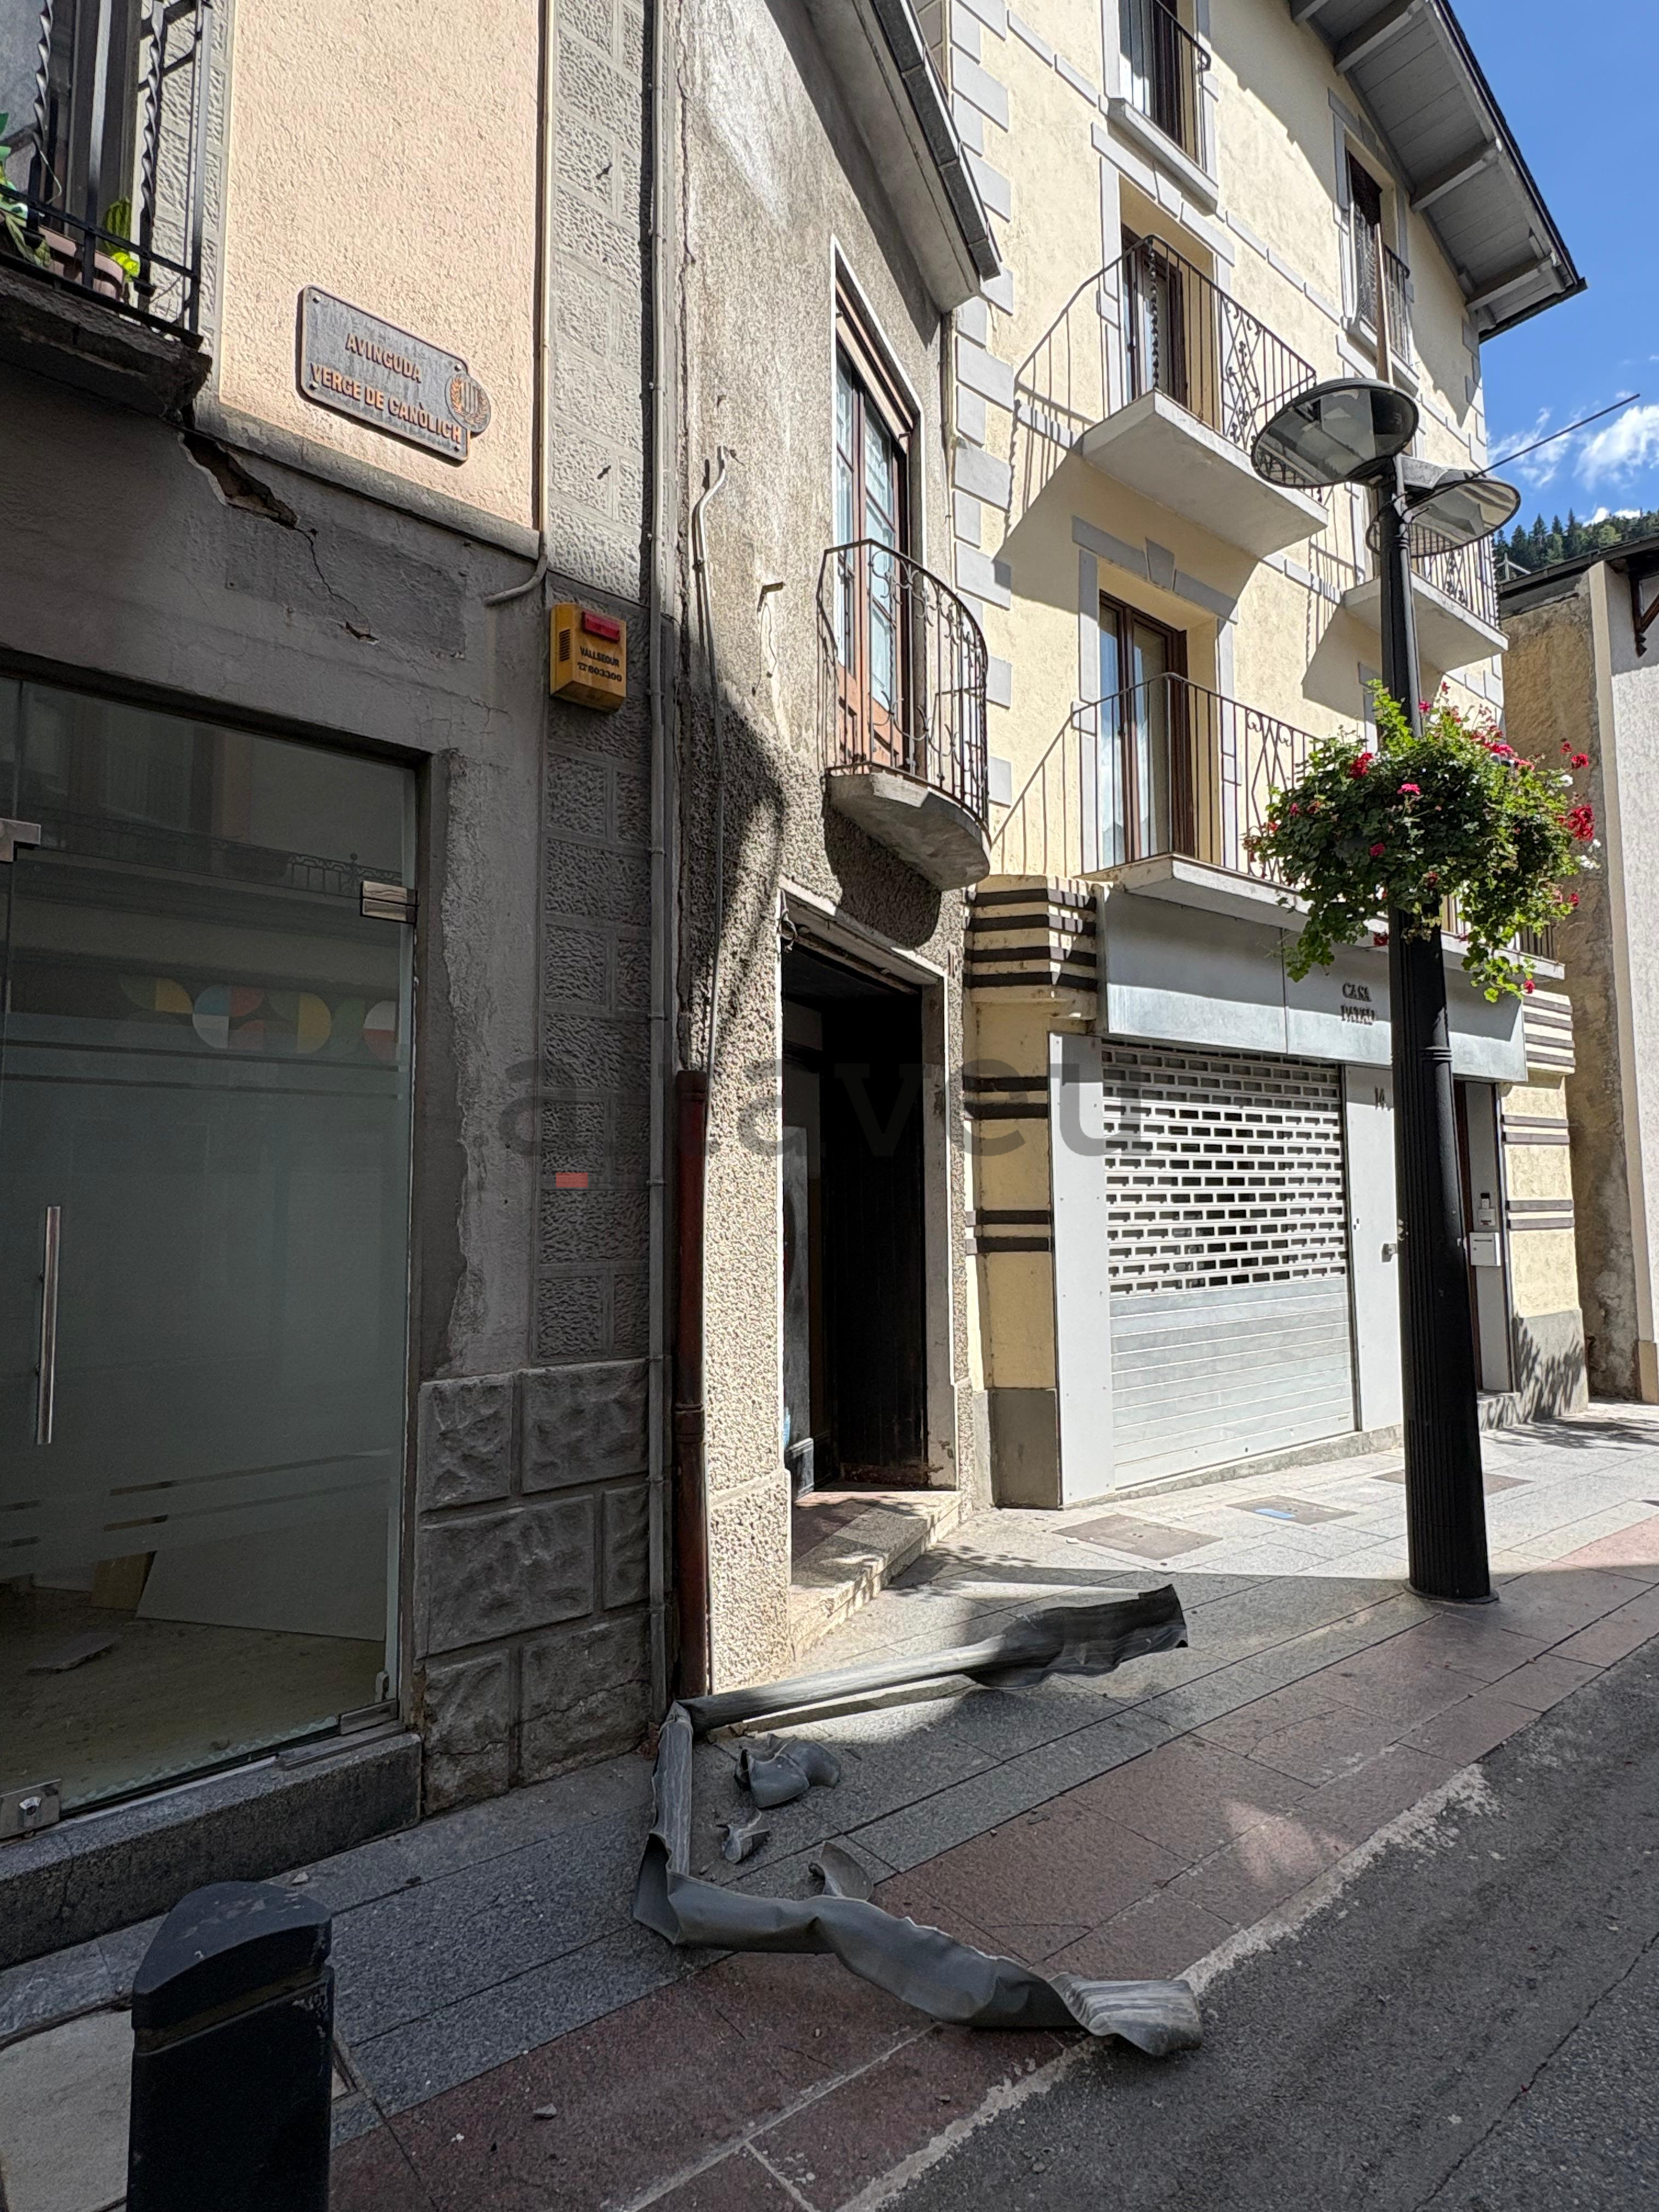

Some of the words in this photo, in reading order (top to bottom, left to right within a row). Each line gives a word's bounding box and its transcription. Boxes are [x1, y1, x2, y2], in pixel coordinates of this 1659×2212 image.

[345, 332, 421, 383] AVINGUDA
[311, 363, 361, 401] VERGE
[365, 386, 385, 411] DE
[387, 397, 461, 443] CANÒLICH
